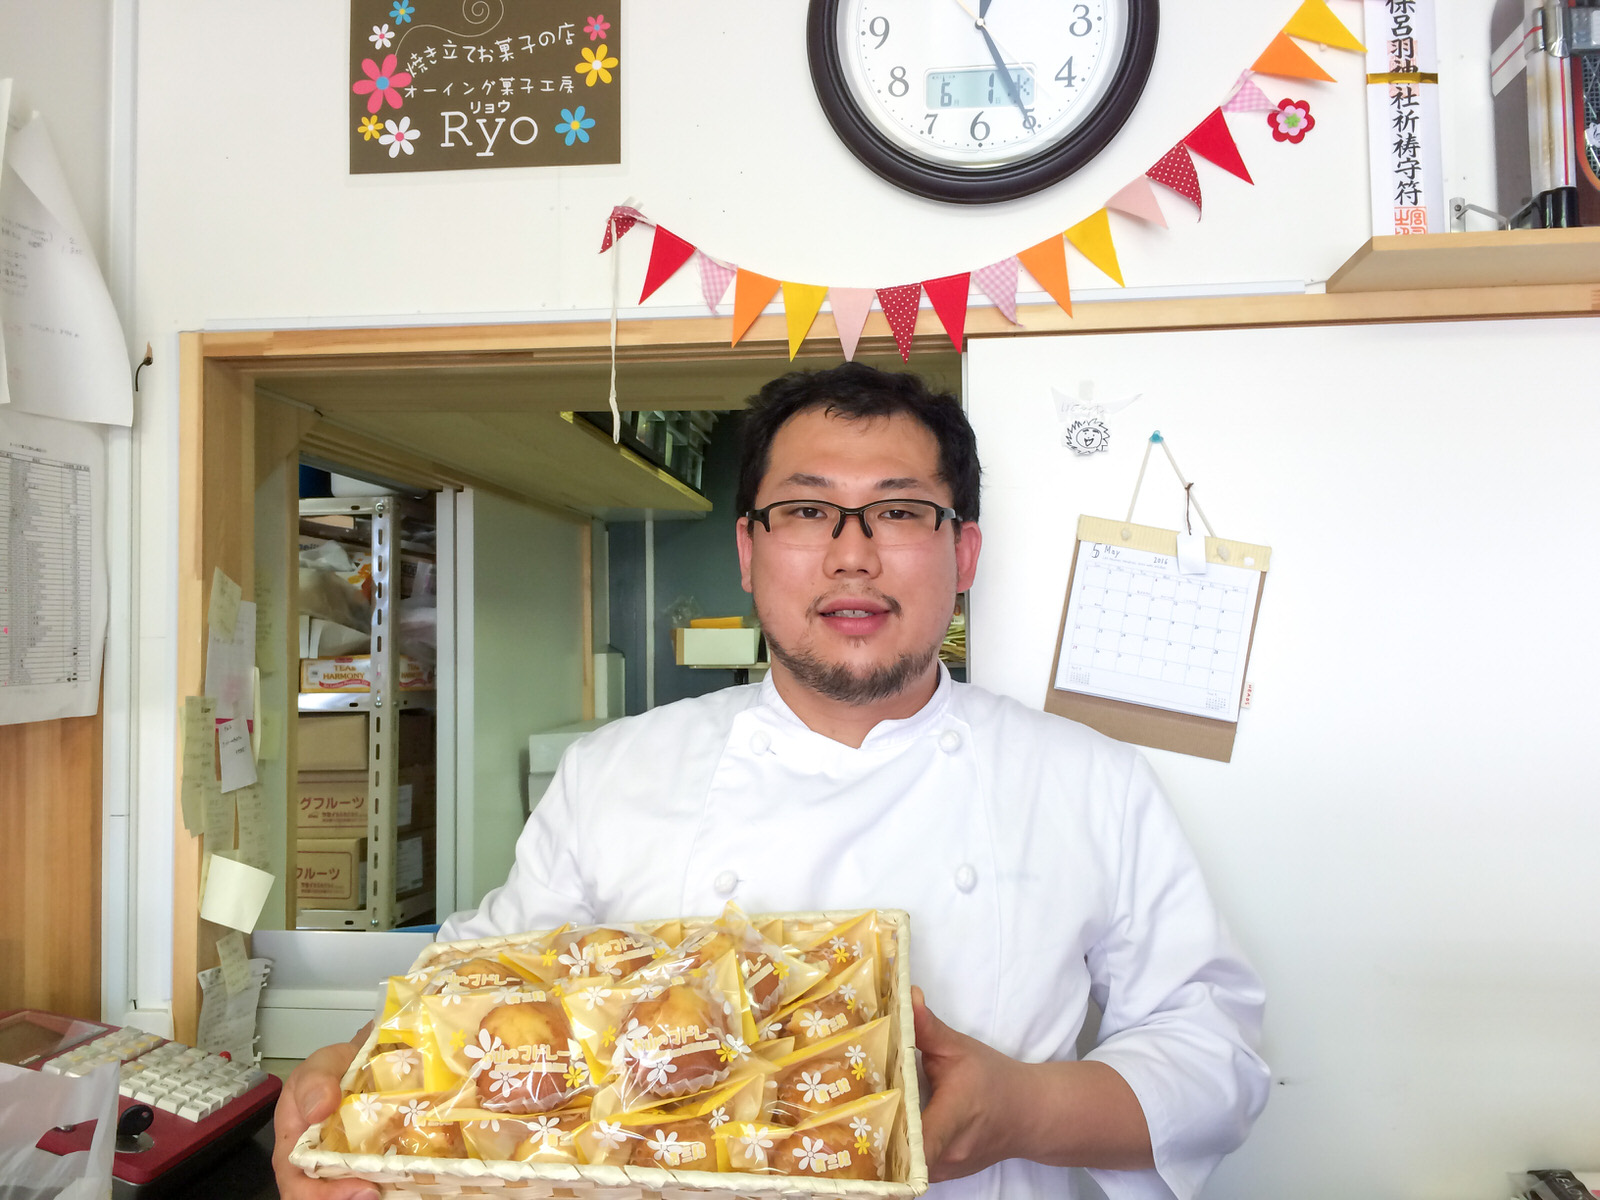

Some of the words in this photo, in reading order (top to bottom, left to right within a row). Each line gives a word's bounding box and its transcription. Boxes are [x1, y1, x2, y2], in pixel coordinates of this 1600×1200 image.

[869, 16, 890, 50] 9
[1069, 4, 1093, 37] 3
[404, 22, 576, 78] 焼き立てお菓子の店
[403, 75, 575, 99] オーイング菓子工房
[887, 66, 910, 97] 8
[1054, 56, 1077, 88] 4
[469, 100, 511, 115] リョウ
[440, 110, 539, 157] Ryo
[924, 113, 939, 135] 7
[969, 110, 991, 141] 6
[1104, 545, 1121, 558] May
[322, 672, 366, 680] HARMONY
